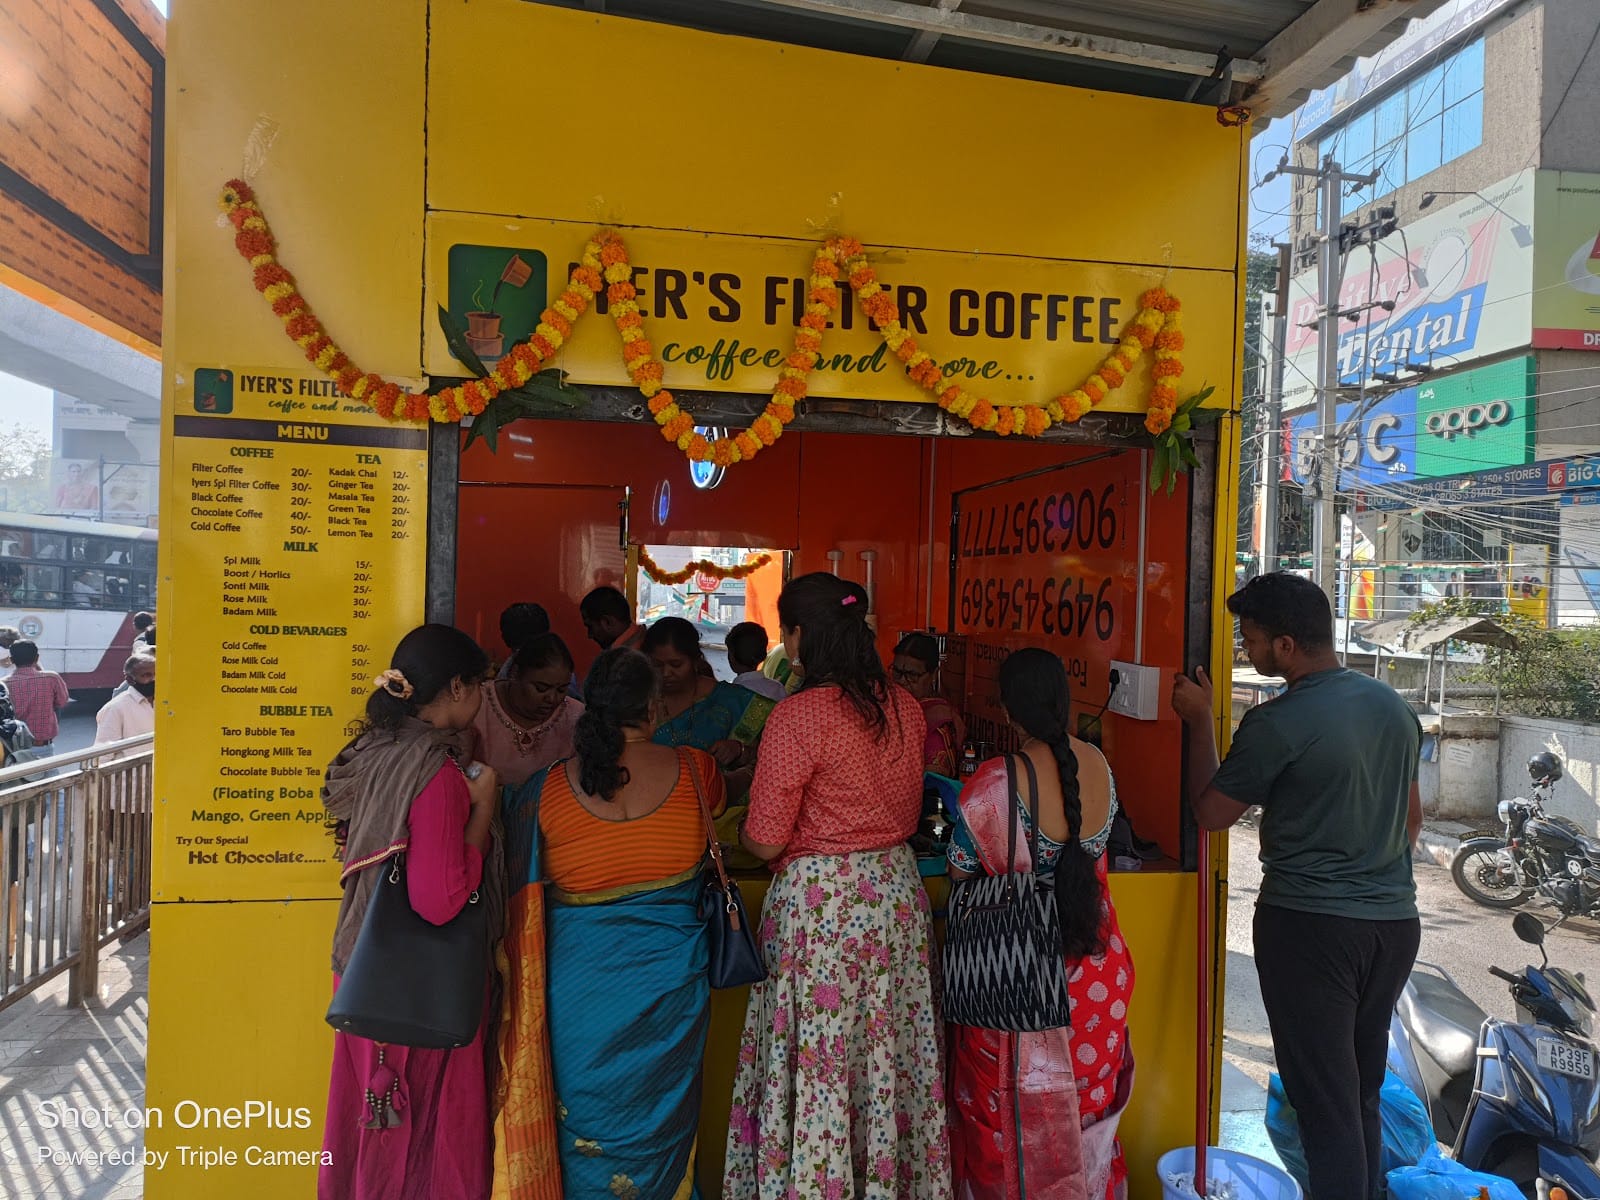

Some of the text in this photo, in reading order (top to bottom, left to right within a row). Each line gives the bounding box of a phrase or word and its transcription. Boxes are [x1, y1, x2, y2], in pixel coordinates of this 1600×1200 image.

[568, 262, 1122, 344] ER'S FITR COFFEE
[1337, 294, 1474, 377] Dental
[662, 338, 1035, 382] coffee and ore...
[241, 375, 350, 398] IYER'S FILTE
[269, 400, 305, 413] coffee
[312, 400, 338, 411] and
[1425, 400, 1509, 440] oppo
[277, 425, 328, 440] MENU
[1367, 413, 1398, 463] C
[230, 447, 273, 458] COFFEE
[356, 454, 381, 464] TEA
[192, 463, 312, 477] Filter Coffee 20/-
[329, 468, 408, 479] Kadak Chai 12/-
[1504, 467, 1541, 483] STORES
[192, 478, 311, 492] Iyers Spl Filter Coffee 30/-
[329, 480, 357, 490] Ginger
[392, 483, 410, 491] 20/-
[192, 492, 311, 506] Black Coffee 20/-
[392, 495, 410, 503] 20/-
[191, 507, 311, 520] Chocolate Coffee 40/-
[392, 507, 409, 515] 20/-
[328, 516, 350, 524] Black
[960, 484, 1117, 558] 9063957777
[191, 522, 311, 535] Cold Coffee 50/-
[284, 542, 318, 552] MILK
[224, 556, 372, 569] Spl Milk 15/-
[224, 569, 249, 577] Boost
[260, 570, 290, 578] Horlics
[354, 573, 372, 582] 20/-
[224, 582, 246, 590] Sonti
[354, 586, 372, 594] 25/-
[353, 598, 371, 606] 30/-
[223, 607, 253, 615] Badam
[257, 608, 277, 616] Milk
[960, 577, 1114, 641] 9493454369
[250, 625, 347, 636] COLD BEVARAGES
[242, 642, 266, 650] Coffee
[222, 656, 239, 664] Rose
[352, 673, 370, 681] 50/-
[221, 685, 258, 693] Chocolate
[280, 686, 297, 694] Cold
[351, 687, 368, 695] 80/-
[260, 706, 333, 716] BUBBLE TEA
[221, 727, 241, 736] Taro
[245, 727, 277, 736] Bubble
[280, 728, 295, 736] Tea
[221, 747, 312, 758] Hongkong Milk Tea
[220, 767, 320, 776] Chocolate Bubble Tea
[213, 787, 274, 801] (Floating
[280, 787, 313, 798] Boba
[192, 810, 243, 824] Mango,
[250, 810, 290, 821] Green
[176, 836, 248, 846] Try Our Special
[189, 851, 218, 864] Hot
[1550, 1044, 1589, 1063] AP39F
